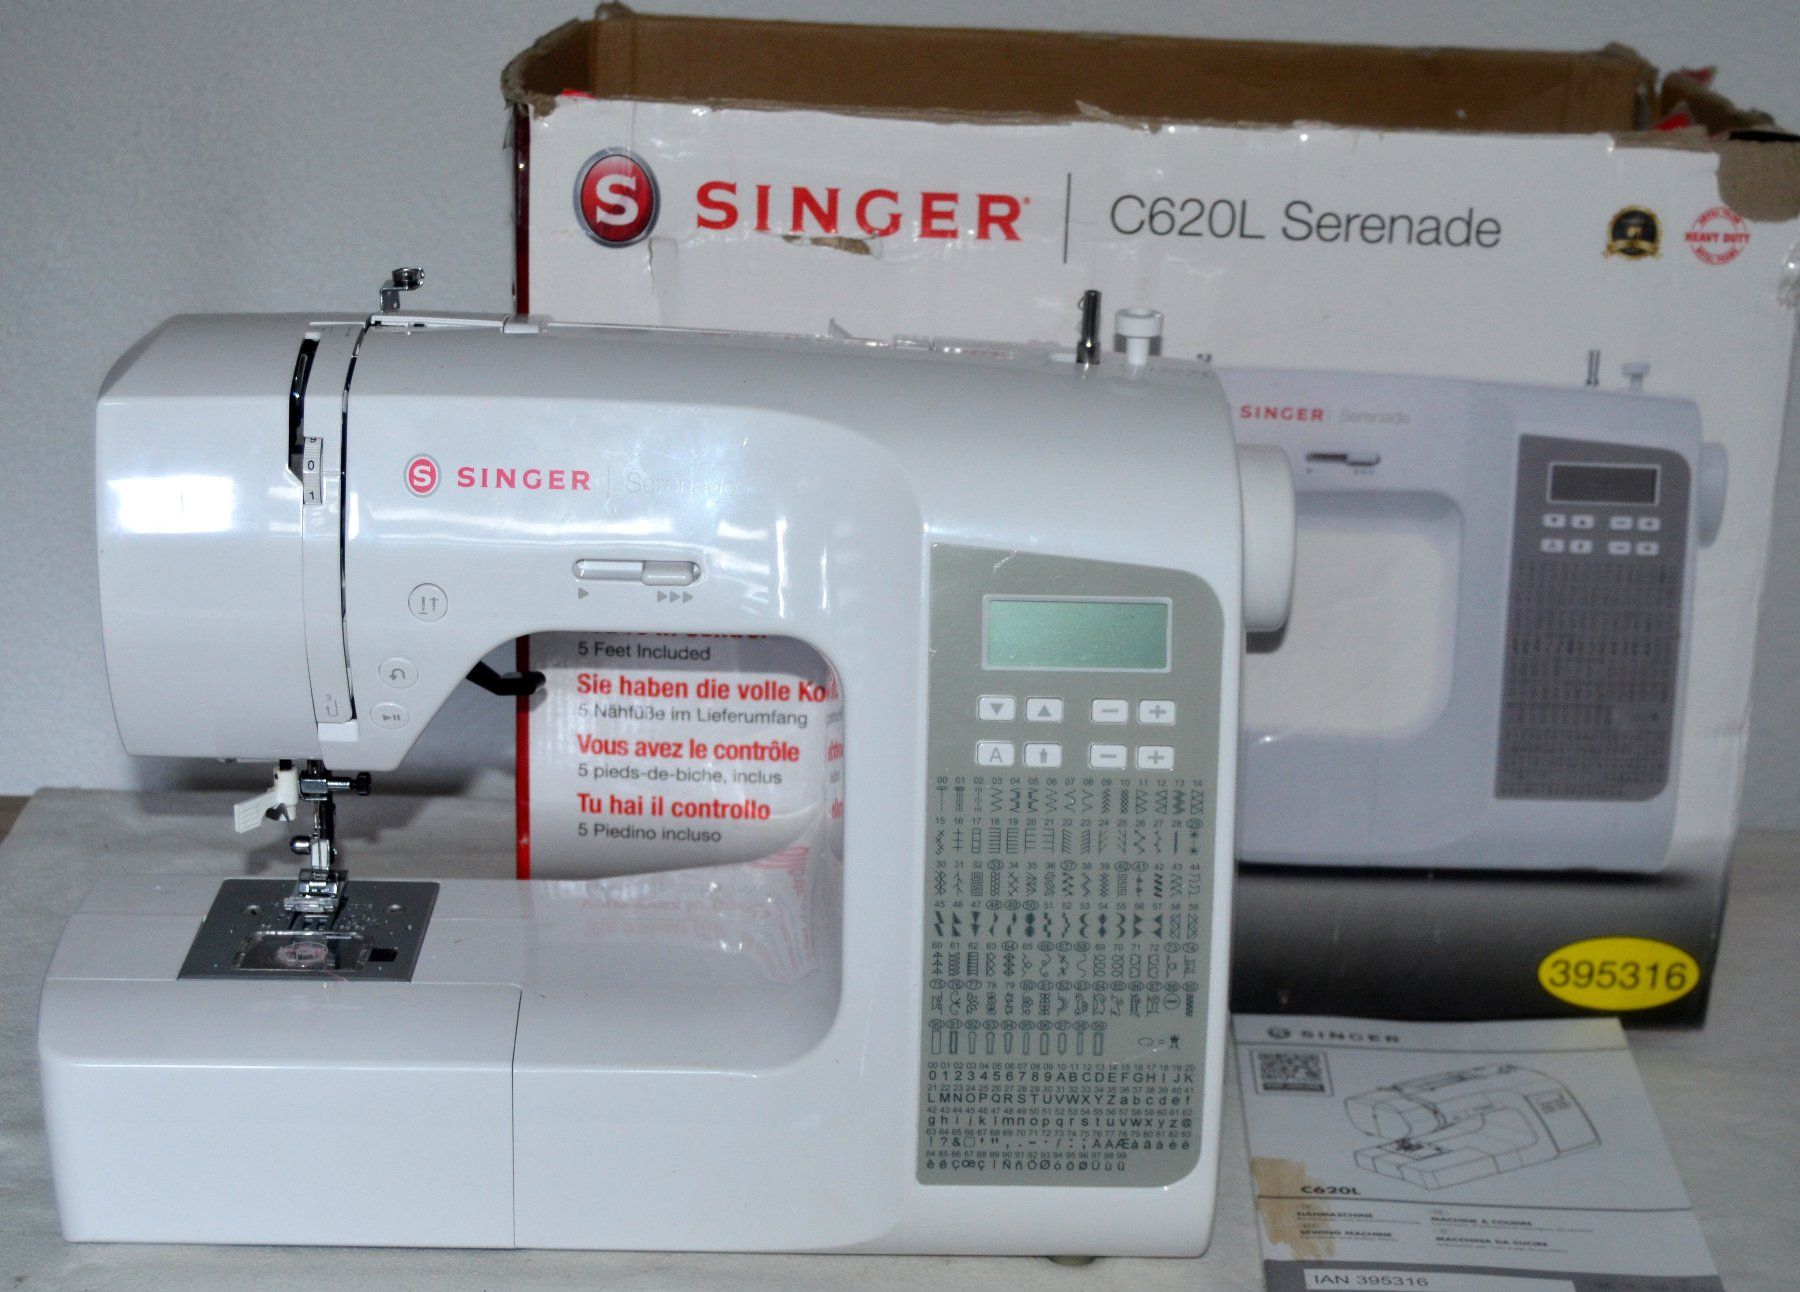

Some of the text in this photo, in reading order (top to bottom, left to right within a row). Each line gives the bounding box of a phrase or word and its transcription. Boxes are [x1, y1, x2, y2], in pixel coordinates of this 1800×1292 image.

[696, 180, 1022, 241] SINGER
[1110, 194, 1264, 240] C620L
[1281, 200, 1501, 248] Serenade
[1240, 405, 1324, 421] SINGER
[457, 466, 590, 491] SINGER
[578, 641, 711, 660] 5 Feet Included
[577, 672, 612, 695] Sie
[620, 675, 688, 698] haben
[696, 678, 730, 699] die
[738, 680, 790, 701] volle
[578, 702, 808, 729] 5 Nähfüße im Lieferumfang
[577, 733, 800, 762] Vous avez le contrôle
[989, 747, 1003, 762] A
[578, 763, 782, 784] 5 pieds-de-biche, inclus
[937, 776, 1202, 787] 00 01 02 03 04 05 06 07 08 09 10 11 12 13 14
[577, 792, 771, 820] Tu hai il controllo
[936, 817, 946, 825] 15
[954, 817, 964, 825] 16
[972, 817, 982, 825] 17
[990, 817, 1000, 826] 18
[1009, 818, 1018, 826] 19
[1026, 818, 1037, 826] 20
[1044, 818, 1055, 826] 21
[1062, 818, 1073, 826] 22
[1080, 818, 1091, 826] 23
[1099, 819, 1109, 827] 24
[1116, 819, 1128, 827] 25
[1136, 819, 1146, 827] 26
[1153, 819, 1164, 827] 27
[1170, 820, 1182, 828] 28
[578, 823, 722, 842] 5 Piedino incluso
[936, 860, 947, 868] 30
[954, 860, 964, 868] 31
[973, 861, 983, 869] 32
[1008, 861, 1019, 869] 34
[1027, 861, 1037, 869] 35
[1045, 862, 1056, 870] 36
[1082, 862, 1092, 870] 38
[1099, 862, 1110, 870] 39
[1154, 863, 1164, 871] 42
[1172, 863, 1182, 871] 43
[1190, 864, 1200, 872] 44
[932, 941, 942, 950] 60
[950, 942, 960, 950] 61
[968, 942, 979, 950] 62
[986, 942, 997, 950] 63
[1022, 942, 1033, 951] 65
[1094, 943, 1106, 951] 69
[1113, 943, 1123, 951] 70
[1131, 943, 1141, 952] 71
[1150, 944, 1160, 952] 72
[1550, 958, 1688, 990] 395316
[986, 980, 1016, 989] 78 79
[1302, 1030, 1399, 1042] SINGER
[1300, 1186, 1361, 1195] C620L
[1315, 1274, 1428, 1287] IAN 395316
